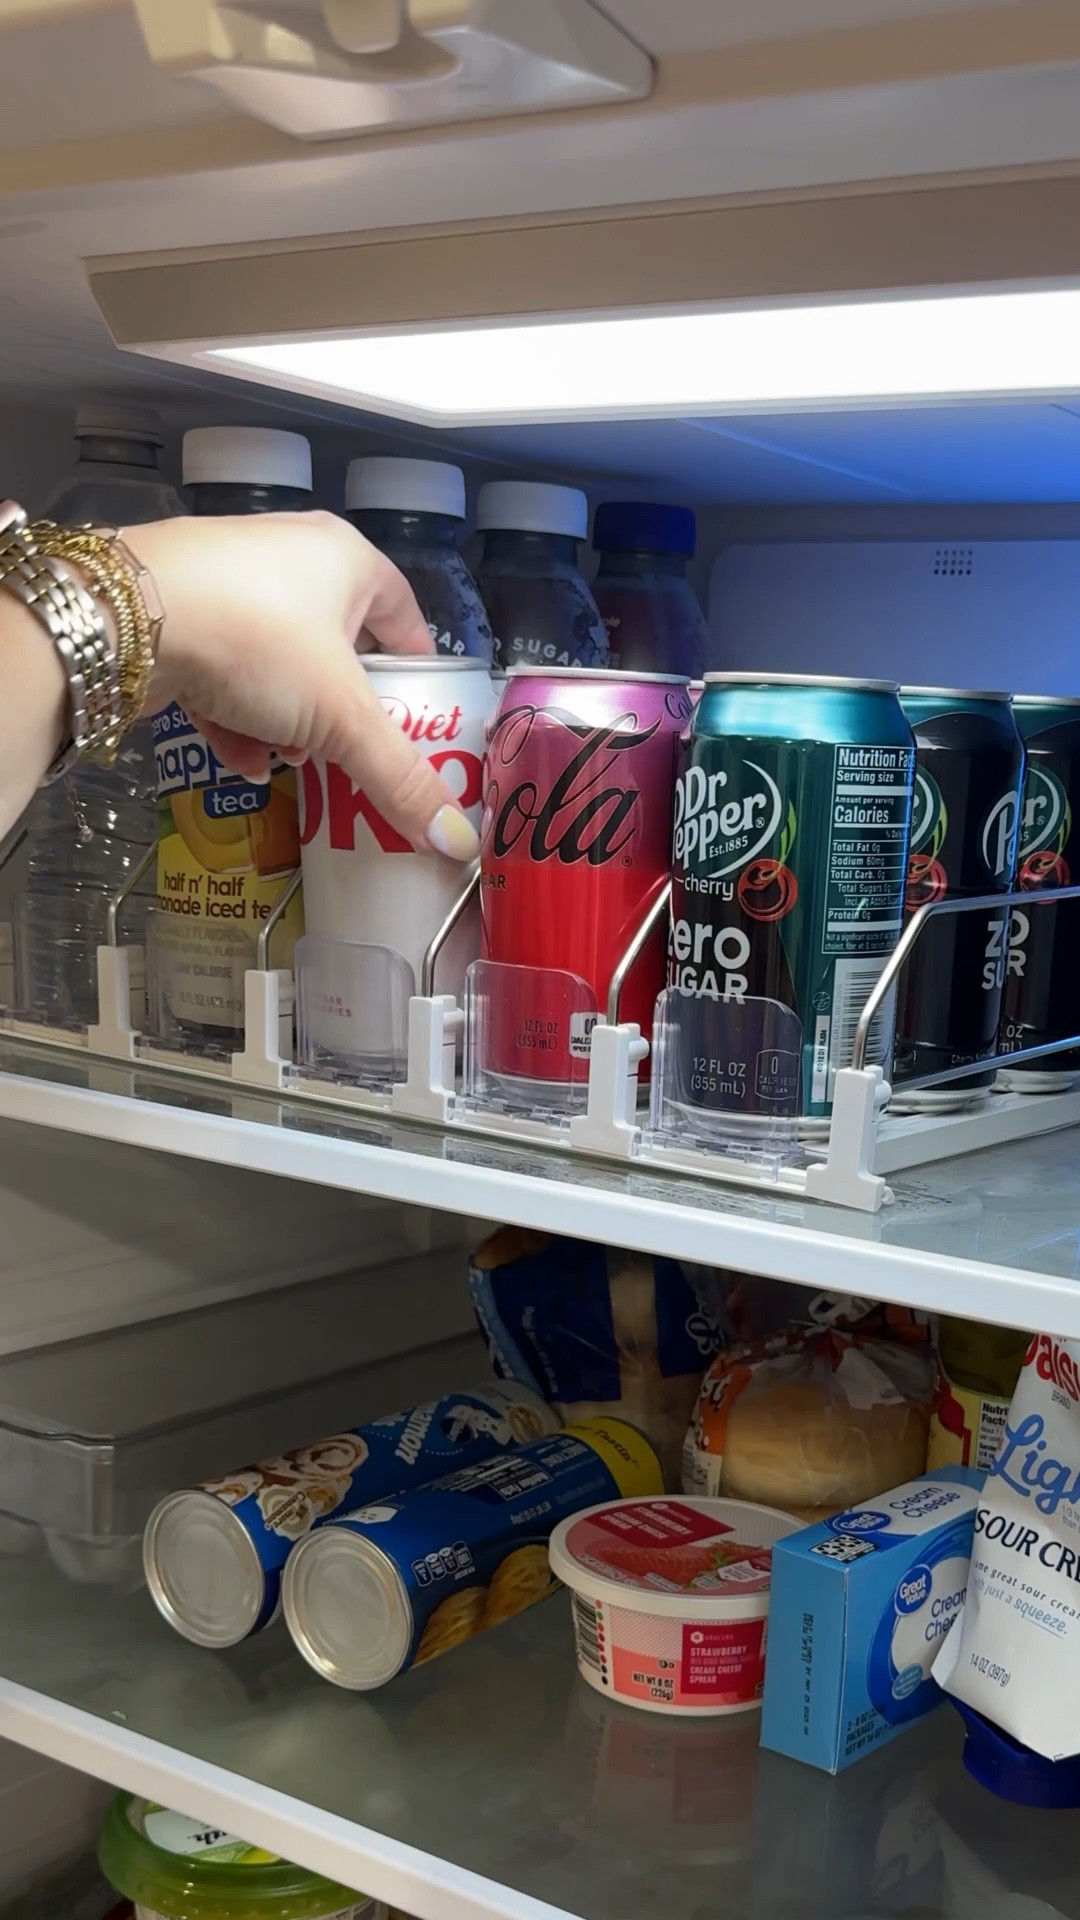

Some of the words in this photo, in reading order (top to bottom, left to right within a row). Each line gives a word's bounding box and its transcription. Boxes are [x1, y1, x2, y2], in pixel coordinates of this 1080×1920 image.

[427, 624, 466, 656] GAR
[838, 747, 897, 768] Nutrition
[836, 769, 876, 785] Serving
[878, 771, 895, 783] size
[213, 791, 260, 815] tea
[684, 765, 728, 821] Dr
[835, 795, 862, 804] Amount
[862, 796, 873, 805] per
[874, 797, 895, 806] serving
[672, 778, 767, 871] Pepper
[834, 804, 890, 823] Calories
[709, 835, 749, 859] Est.1885
[832, 842, 854, 852] Total
[856, 843, 870, 852] Fat
[871, 843, 881, 854] 0g
[831, 856, 864, 866] Sodium
[164, 870, 186, 893] half
[207, 875, 245, 897] half
[830, 869, 852, 880] Total
[854, 870, 876, 880] Carb.
[684, 872, 734, 902] cherry
[837, 883, 857, 893] Total
[859, 883, 883, 894] Sugars
[158, 895, 202, 916] onade
[205, 897, 247, 919] iced
[828, 910, 860, 920] Protein
[861, 910, 872, 921] 0g
[667, 918, 751, 970] zero
[666, 959, 749, 1005] UGAR
[524, 1019, 532, 1032] 12
[535, 1020, 543, 1033] FL
[546, 1022, 558, 1035] OZ
[1006, 1024, 1023, 1039] OZ
[692, 1056, 706, 1072] 12
[709, 1059, 724, 1075] FL
[728, 1061, 747, 1078] OZ
[770, 1056, 779, 1075] 0
[690, 1074, 717, 1092] (355
[720, 1081, 746, 1099] mL)
[982, 1402, 1009, 1416] Nutri
[989, 1414, 1080, 1515] Lig
[888, 1485, 943, 1512] Cream
[902, 1491, 962, 1519] Cheese
[974, 1508, 1040, 1558] SOUR
[1038, 1541, 1080, 1584] CRE
[899, 1573, 927, 1600] Great
[991, 1568, 1018, 1589] great
[1020, 1581, 1047, 1601] sour
[983, 1583, 1006, 1602] just
[1004, 1595, 1013, 1605] a
[1013, 1597, 1068, 1636] squeeze.
[924, 1613, 958, 1642] Chee
[690, 1645, 748, 1657] STRAWBERRY
[633, 1672, 645, 1683] NET
[664, 1678, 673, 1689] OZ
[689, 1675, 717, 1684] SPREAD
[690, 1666, 716, 1675] CREAM
[716, 1664, 742, 1674] CHEESE
[969, 1652, 979, 1667] 14
[977, 1658, 989, 1675] OZ
[986, 1663, 1012, 1688] (397g)
